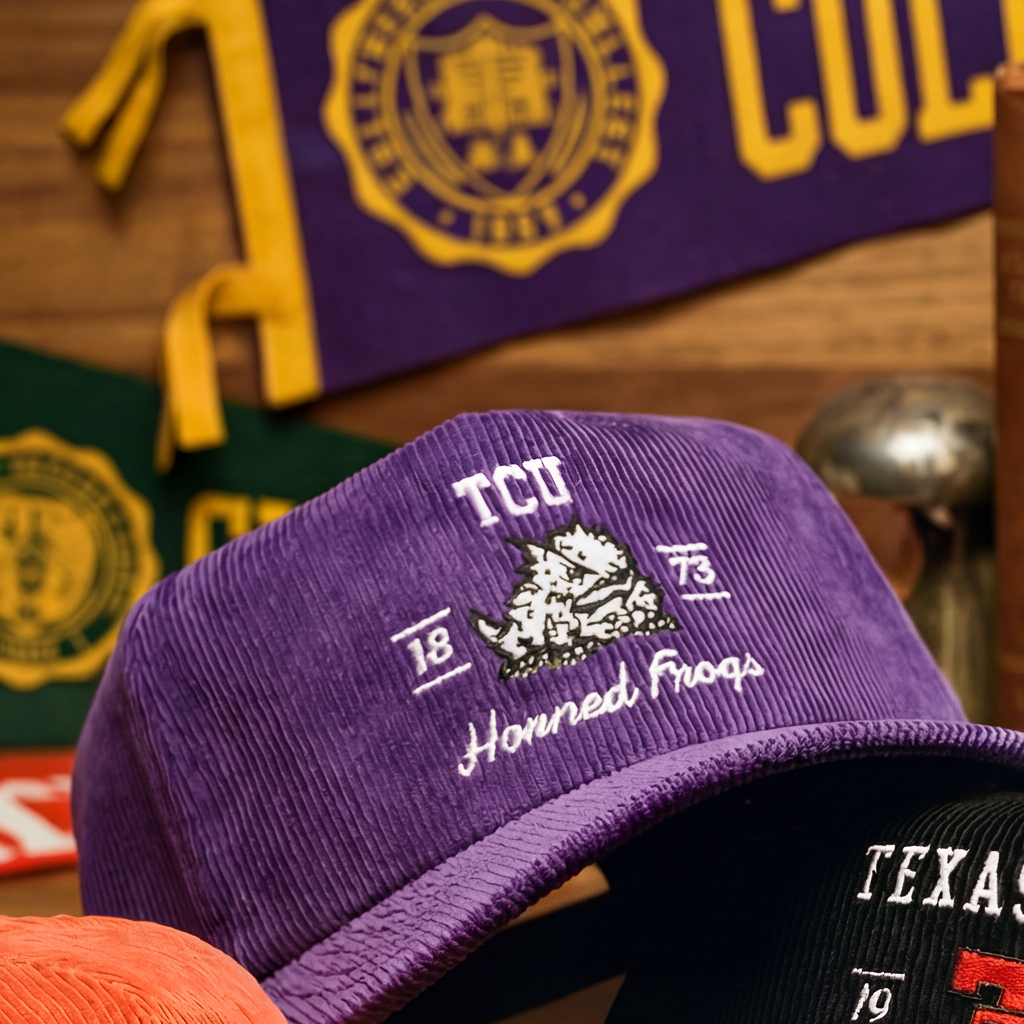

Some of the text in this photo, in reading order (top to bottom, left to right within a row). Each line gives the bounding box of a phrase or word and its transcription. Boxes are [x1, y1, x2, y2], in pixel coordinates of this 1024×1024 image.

[451, 456, 573, 528] TCU
[669, 556, 716, 586] 73
[407, 627, 454, 676] 18
[850, 982, 893, 1022] 19
